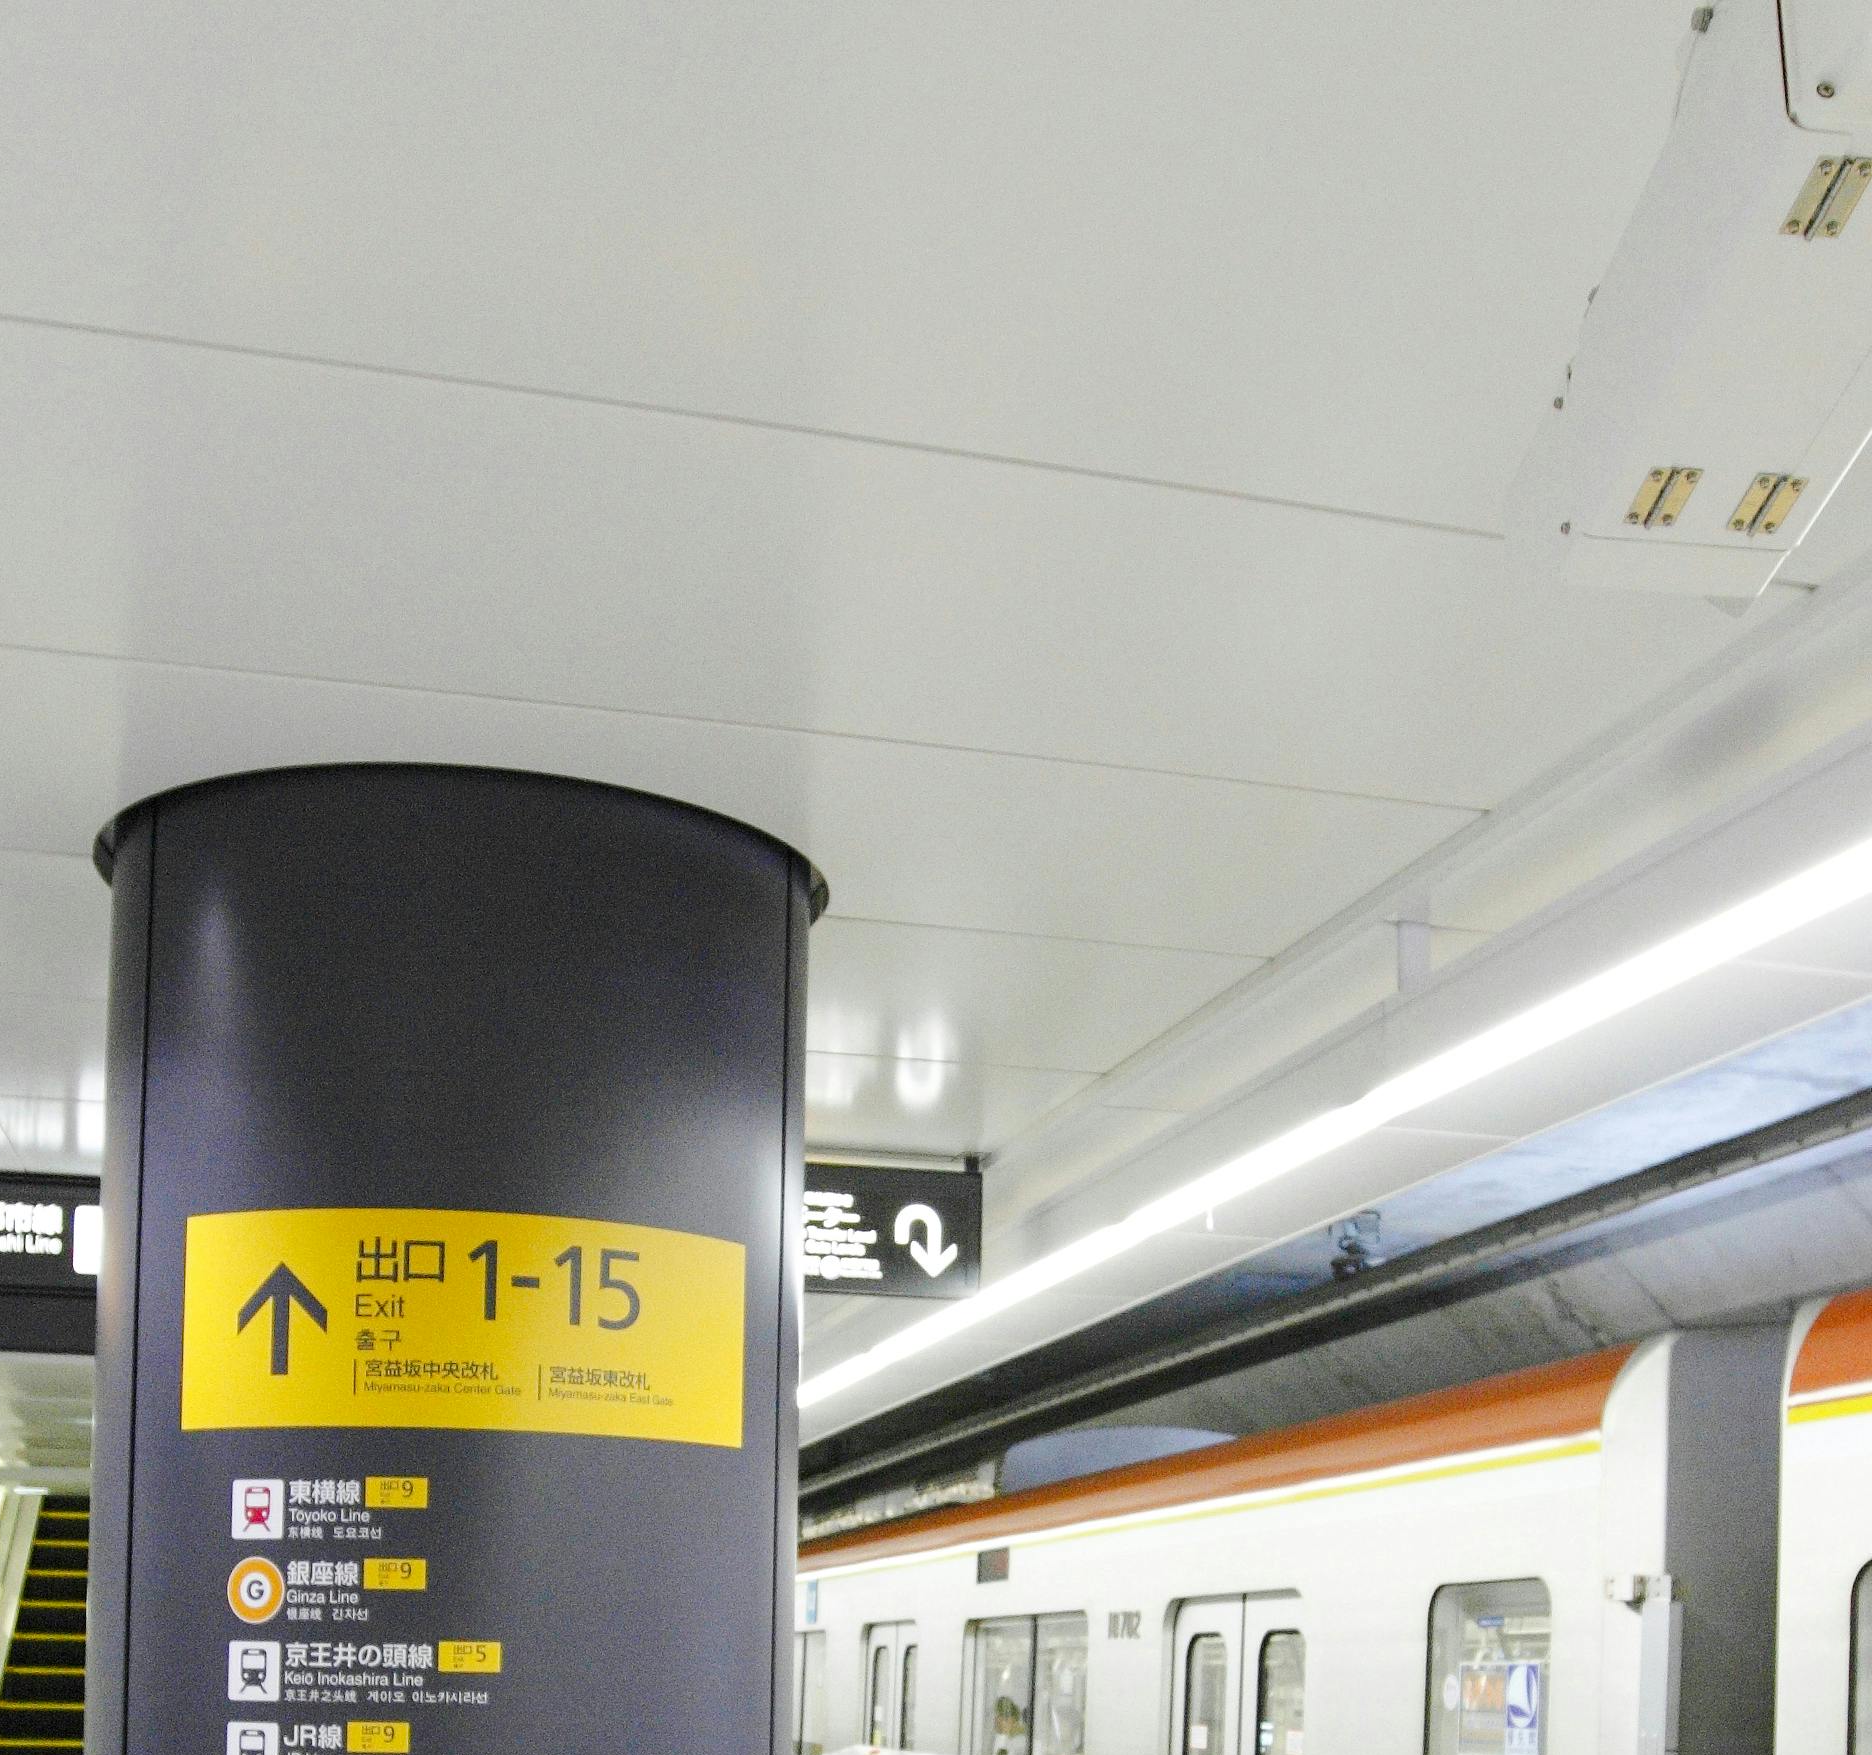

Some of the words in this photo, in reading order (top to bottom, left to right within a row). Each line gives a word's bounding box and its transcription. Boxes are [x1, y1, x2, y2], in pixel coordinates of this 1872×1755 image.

[25, 1234, 63, 1255] Line
[355, 1236, 446, 1283] 出口
[468, 1240, 641, 1331] 1-15
[355, 1293, 405, 1319] Exit
[355, 1328, 402, 1351] 출구
[365, 1359, 499, 1381] 宮益坂中央改札
[549, 1365, 651, 1392] 宮益坂東改札
[363, 1381, 450, 1396] Miyamasu-zaka
[454, 1383, 493, 1397] Center
[494, 1384, 522, 1398] Gate
[548, 1386, 627, 1404] Miyamasu-zaka
[629, 1391, 651, 1405] East
[652, 1395, 674, 1407] Gate
[288, 1480, 361, 1505] 東横線
[379, 1480, 399, 1491] 出口
[401, 1480, 414, 1498] 9
[341, 1509, 371, 1522] Line
[333, 1526, 382, 1540] 도요코선
[287, 1561, 359, 1587] 銀座線
[400, 1562, 412, 1579] 9
[246, 1580, 264, 1601] G
[286, 1590, 326, 1604] Ginza
[329, 1590, 360, 1604] Line
[332, 1608, 369, 1622] 긴자선
[285, 1643, 434, 1669] 京王井の頭線
[453, 1645, 473, 1656] 出口
[475, 1645, 487, 1663] 5
[317, 1672, 389, 1687] Inokashira
[393, 1673, 424, 1687] Line
[283, 1724, 343, 1749] JR線
[361, 1726, 381, 1736] 出口
[383, 1725, 395, 1743] 9
